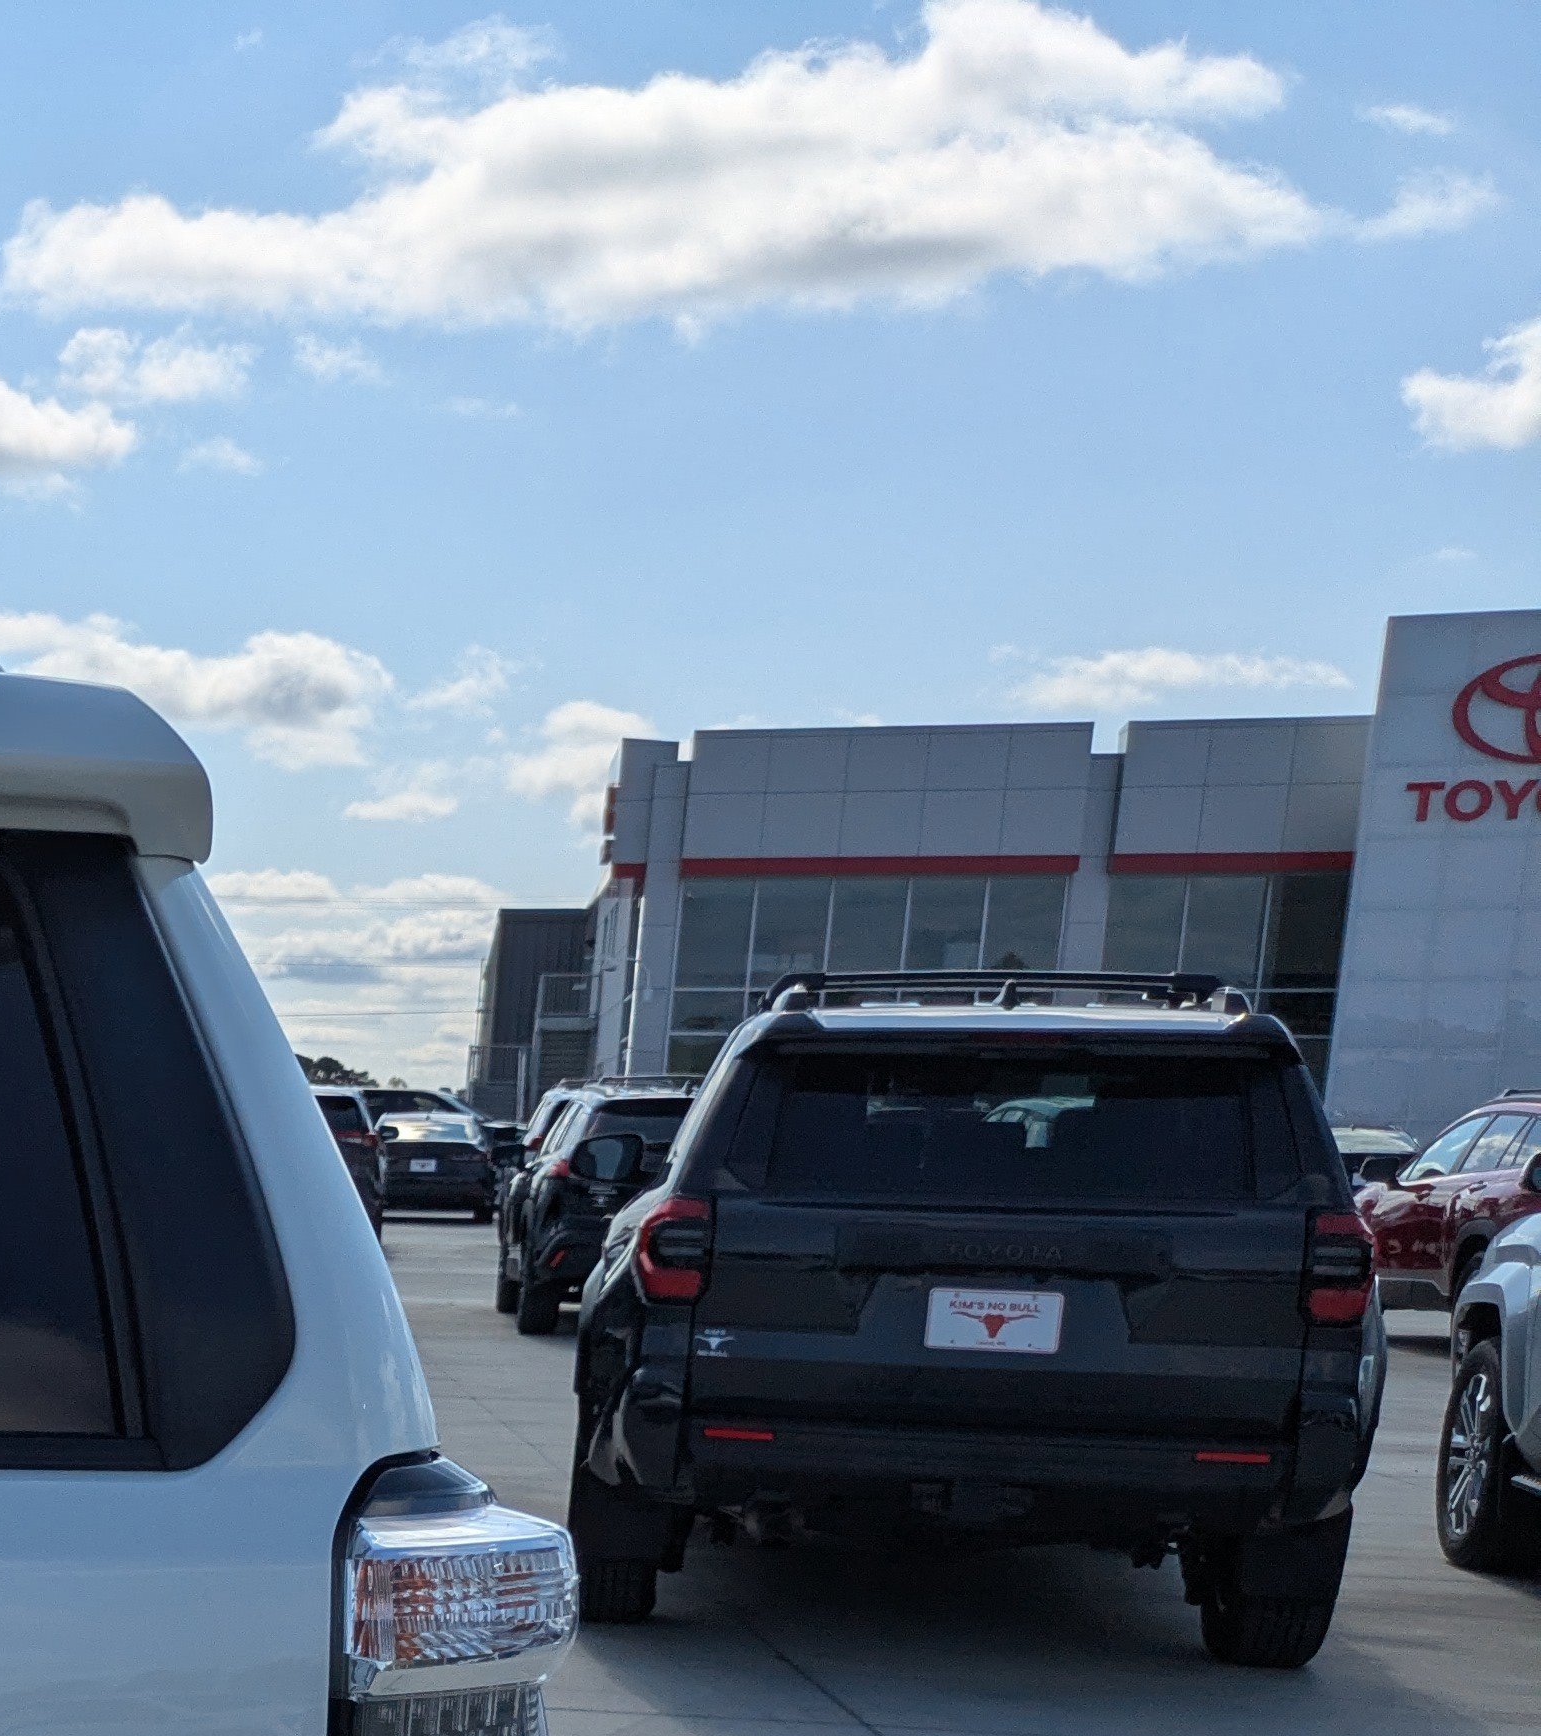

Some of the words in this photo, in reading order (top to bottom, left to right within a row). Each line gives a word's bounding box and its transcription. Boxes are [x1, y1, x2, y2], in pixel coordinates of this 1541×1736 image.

[1404, 779, 1541, 823] TOY
[988, 1302, 1006, 1311] NO
[1009, 1302, 1041, 1313] BULL
